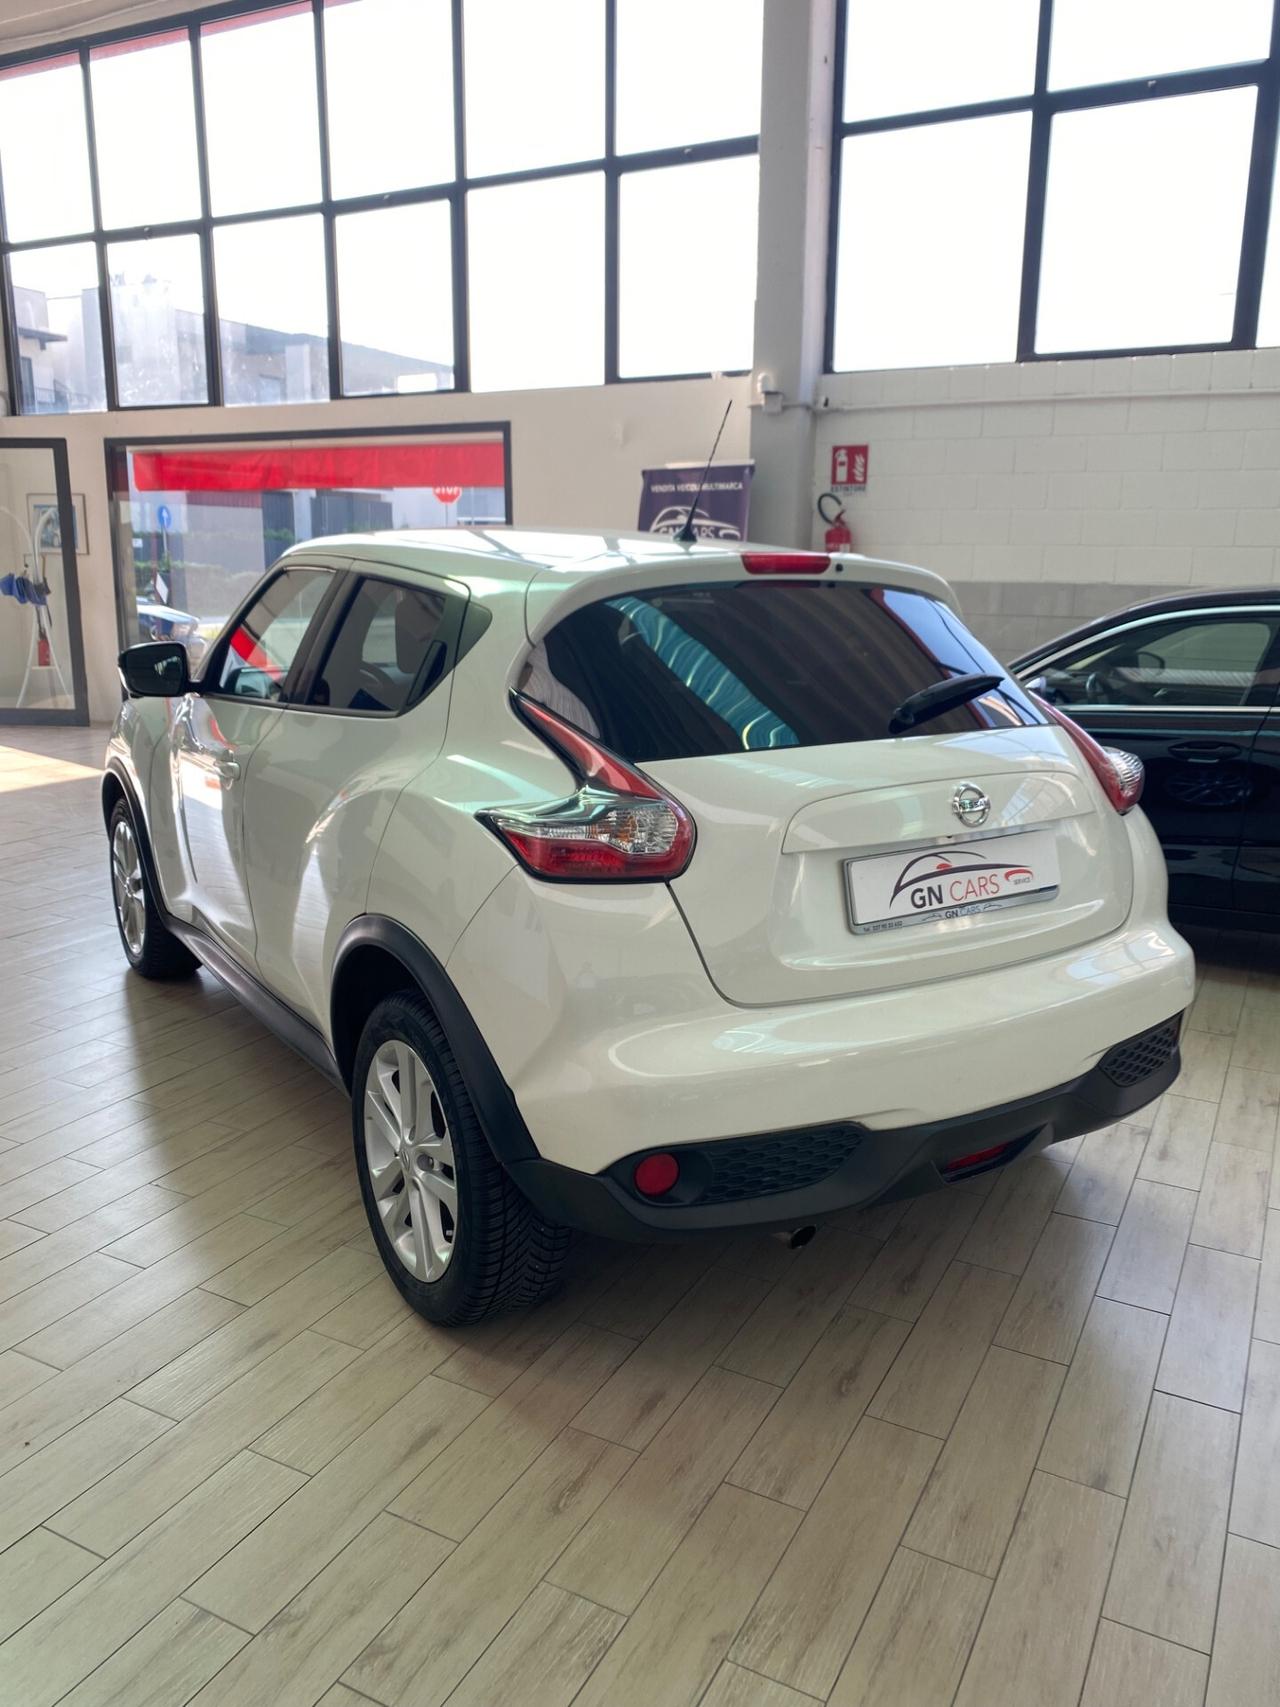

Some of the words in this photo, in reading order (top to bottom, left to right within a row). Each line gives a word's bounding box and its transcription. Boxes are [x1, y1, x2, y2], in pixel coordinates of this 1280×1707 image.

[651, 484, 675, 493] VENDITA
[911, 885, 943, 908] GN
[949, 873, 1000, 902] CARS
[945, 909, 959, 919] GN
[960, 905, 981, 916] CARS
